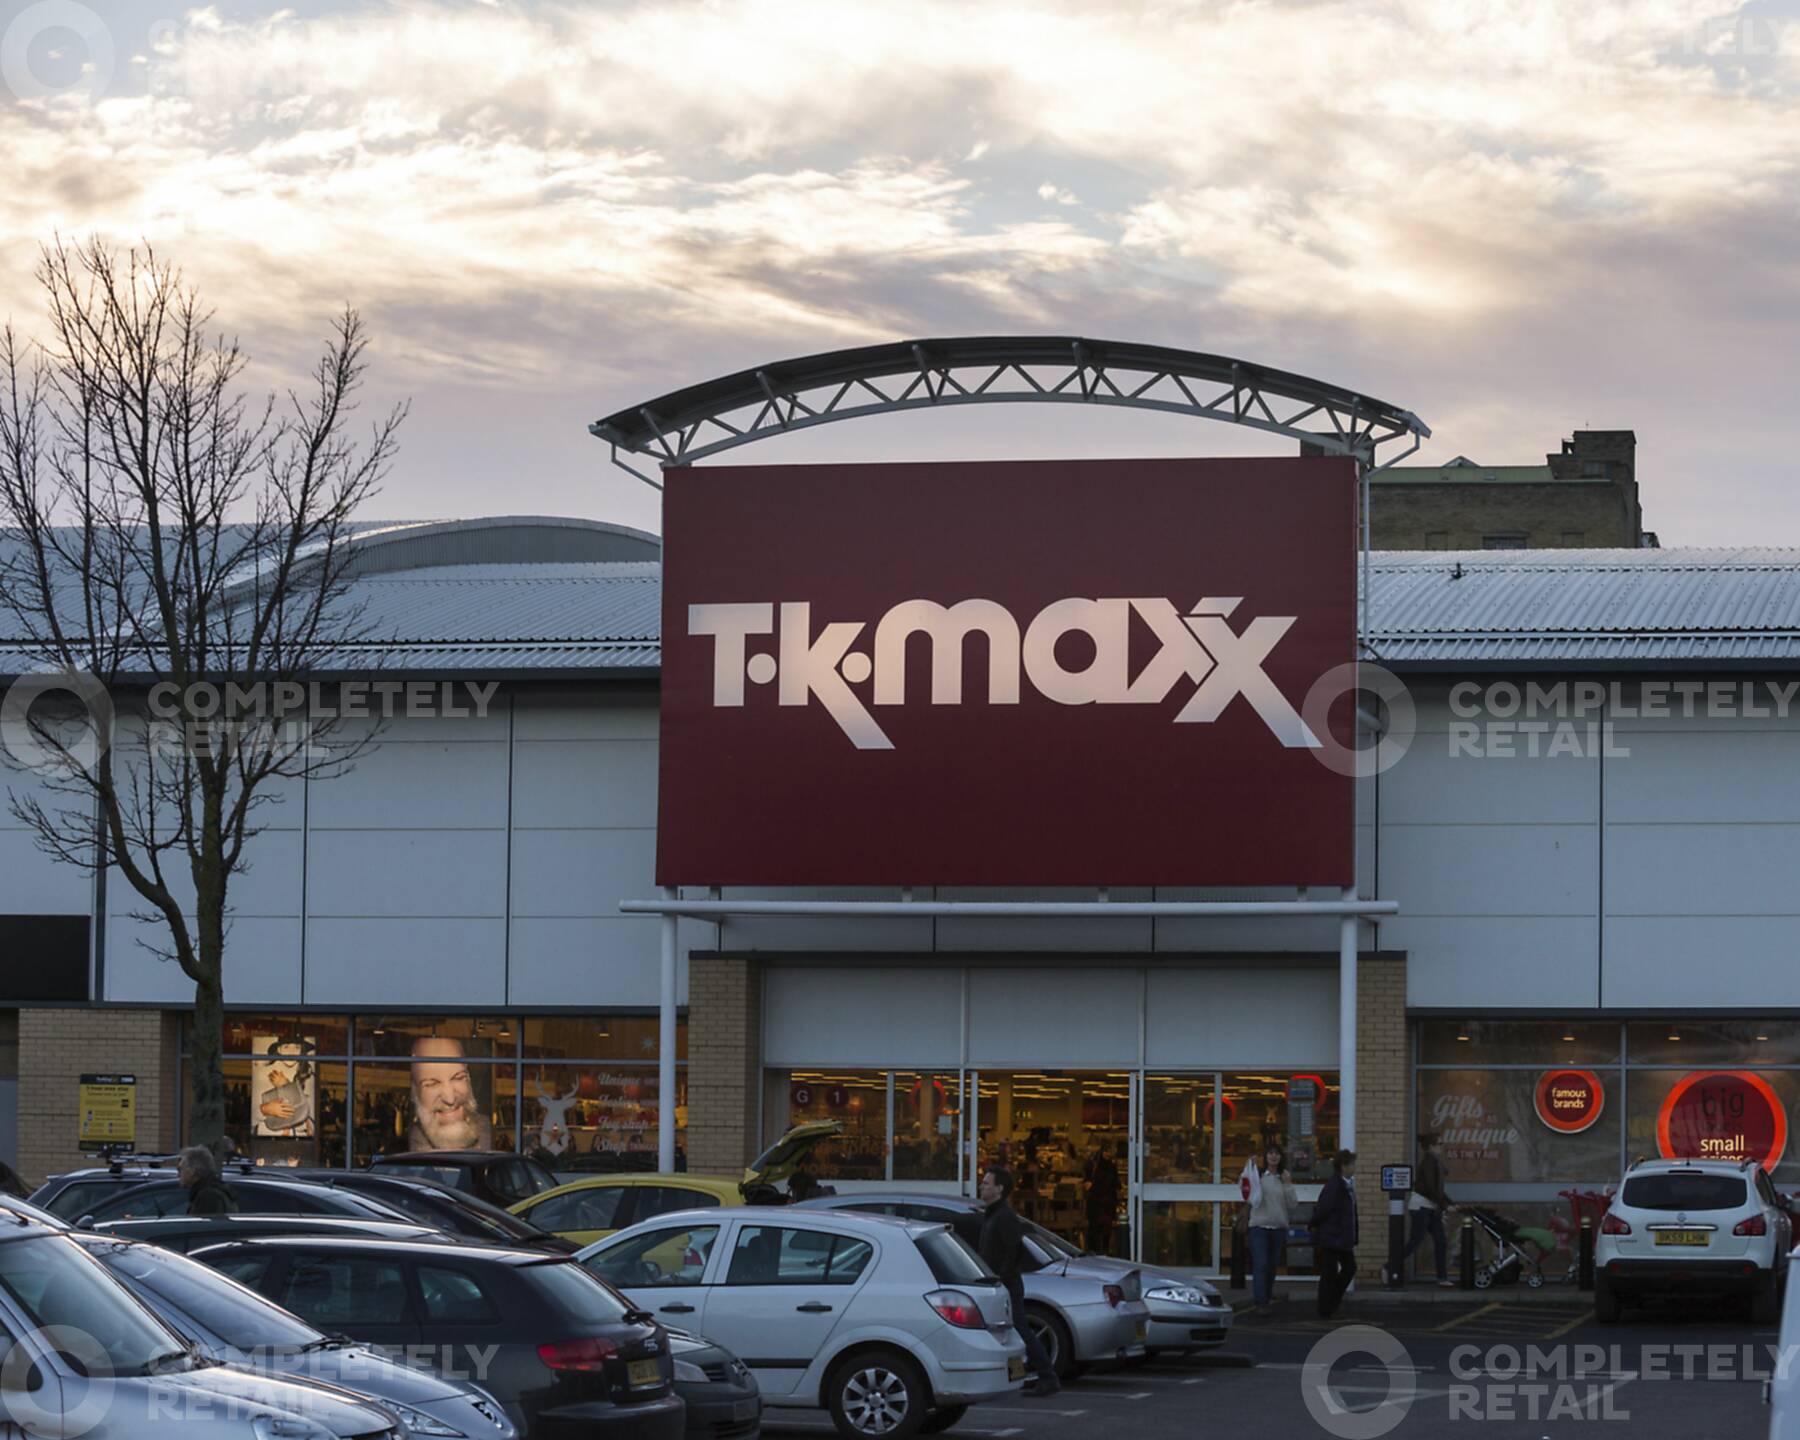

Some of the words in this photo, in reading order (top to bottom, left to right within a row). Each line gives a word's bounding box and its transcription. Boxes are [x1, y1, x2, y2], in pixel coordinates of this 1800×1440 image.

[796, 1089, 809, 1104] G
[1552, 1087, 1587, 1098] famous
[1430, 1094, 1484, 1127] Gifts
[1553, 1098, 1585, 1109] brands
[1702, 1088, 1744, 1118] big
[1438, 1121, 1520, 1150] unique
[1700, 1134, 1745, 1152] small
